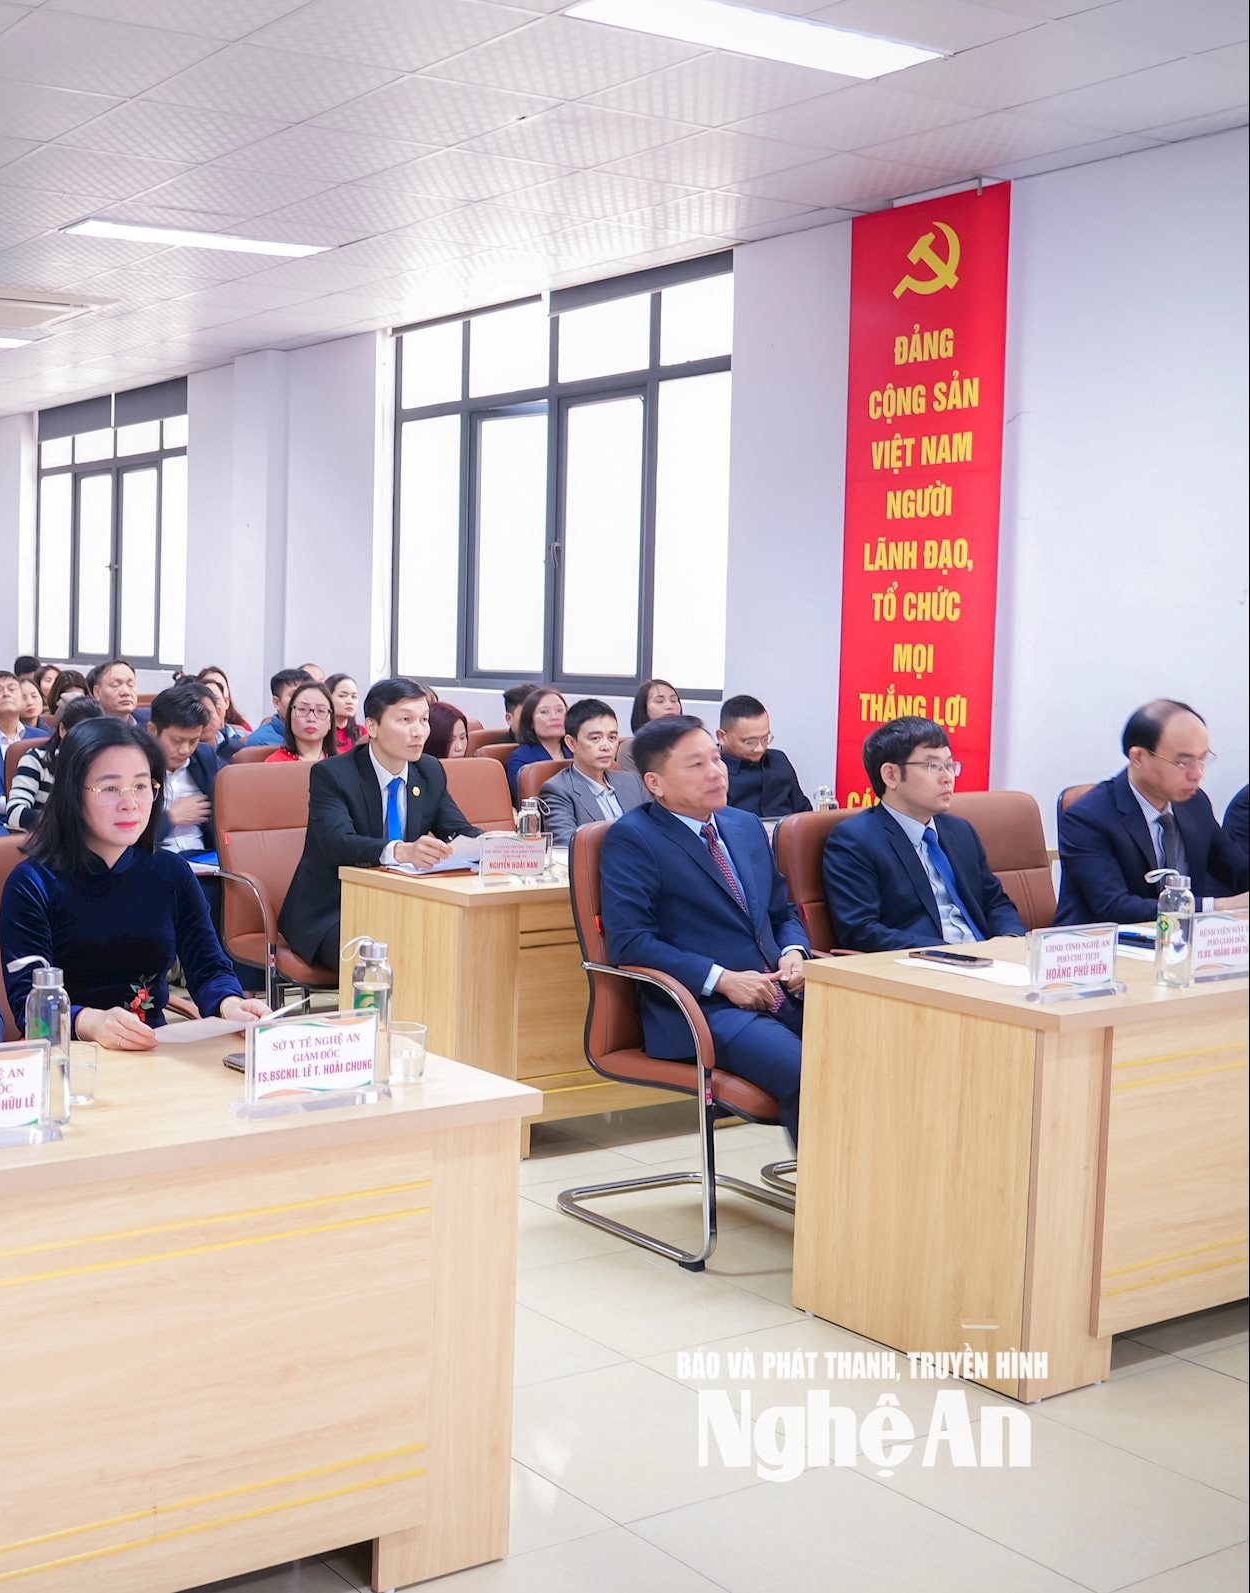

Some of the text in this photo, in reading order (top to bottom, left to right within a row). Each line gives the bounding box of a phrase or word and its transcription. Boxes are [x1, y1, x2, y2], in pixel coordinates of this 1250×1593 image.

[894, 324, 954, 365] ĐẢNG
[869, 370, 979, 424] CỘNG SẢN
[871, 431, 972, 474] VIỆT NAM
[886, 480, 952, 519] NGƯỜI
[864, 537, 973, 575] LÃNH ĐẠO,
[872, 581, 961, 622] TỔ CHỨC
[893, 644, 934, 679] MỌI
[859, 684, 967, 733] THẮNG LỢI
[1046, 965, 1071, 980] HOÀNG
[272, 1032, 360, 1051] SỞ Y TẾ NGHỆ AN
[293, 1048, 340, 1063] GIÁM ĐỐC
[8, 1068, 25, 1079] AN
[323, 1060, 343, 1075] HOÀI
[346, 1059, 372, 1073] CHUNG
[1, 1097, 22, 1110] HỮU
